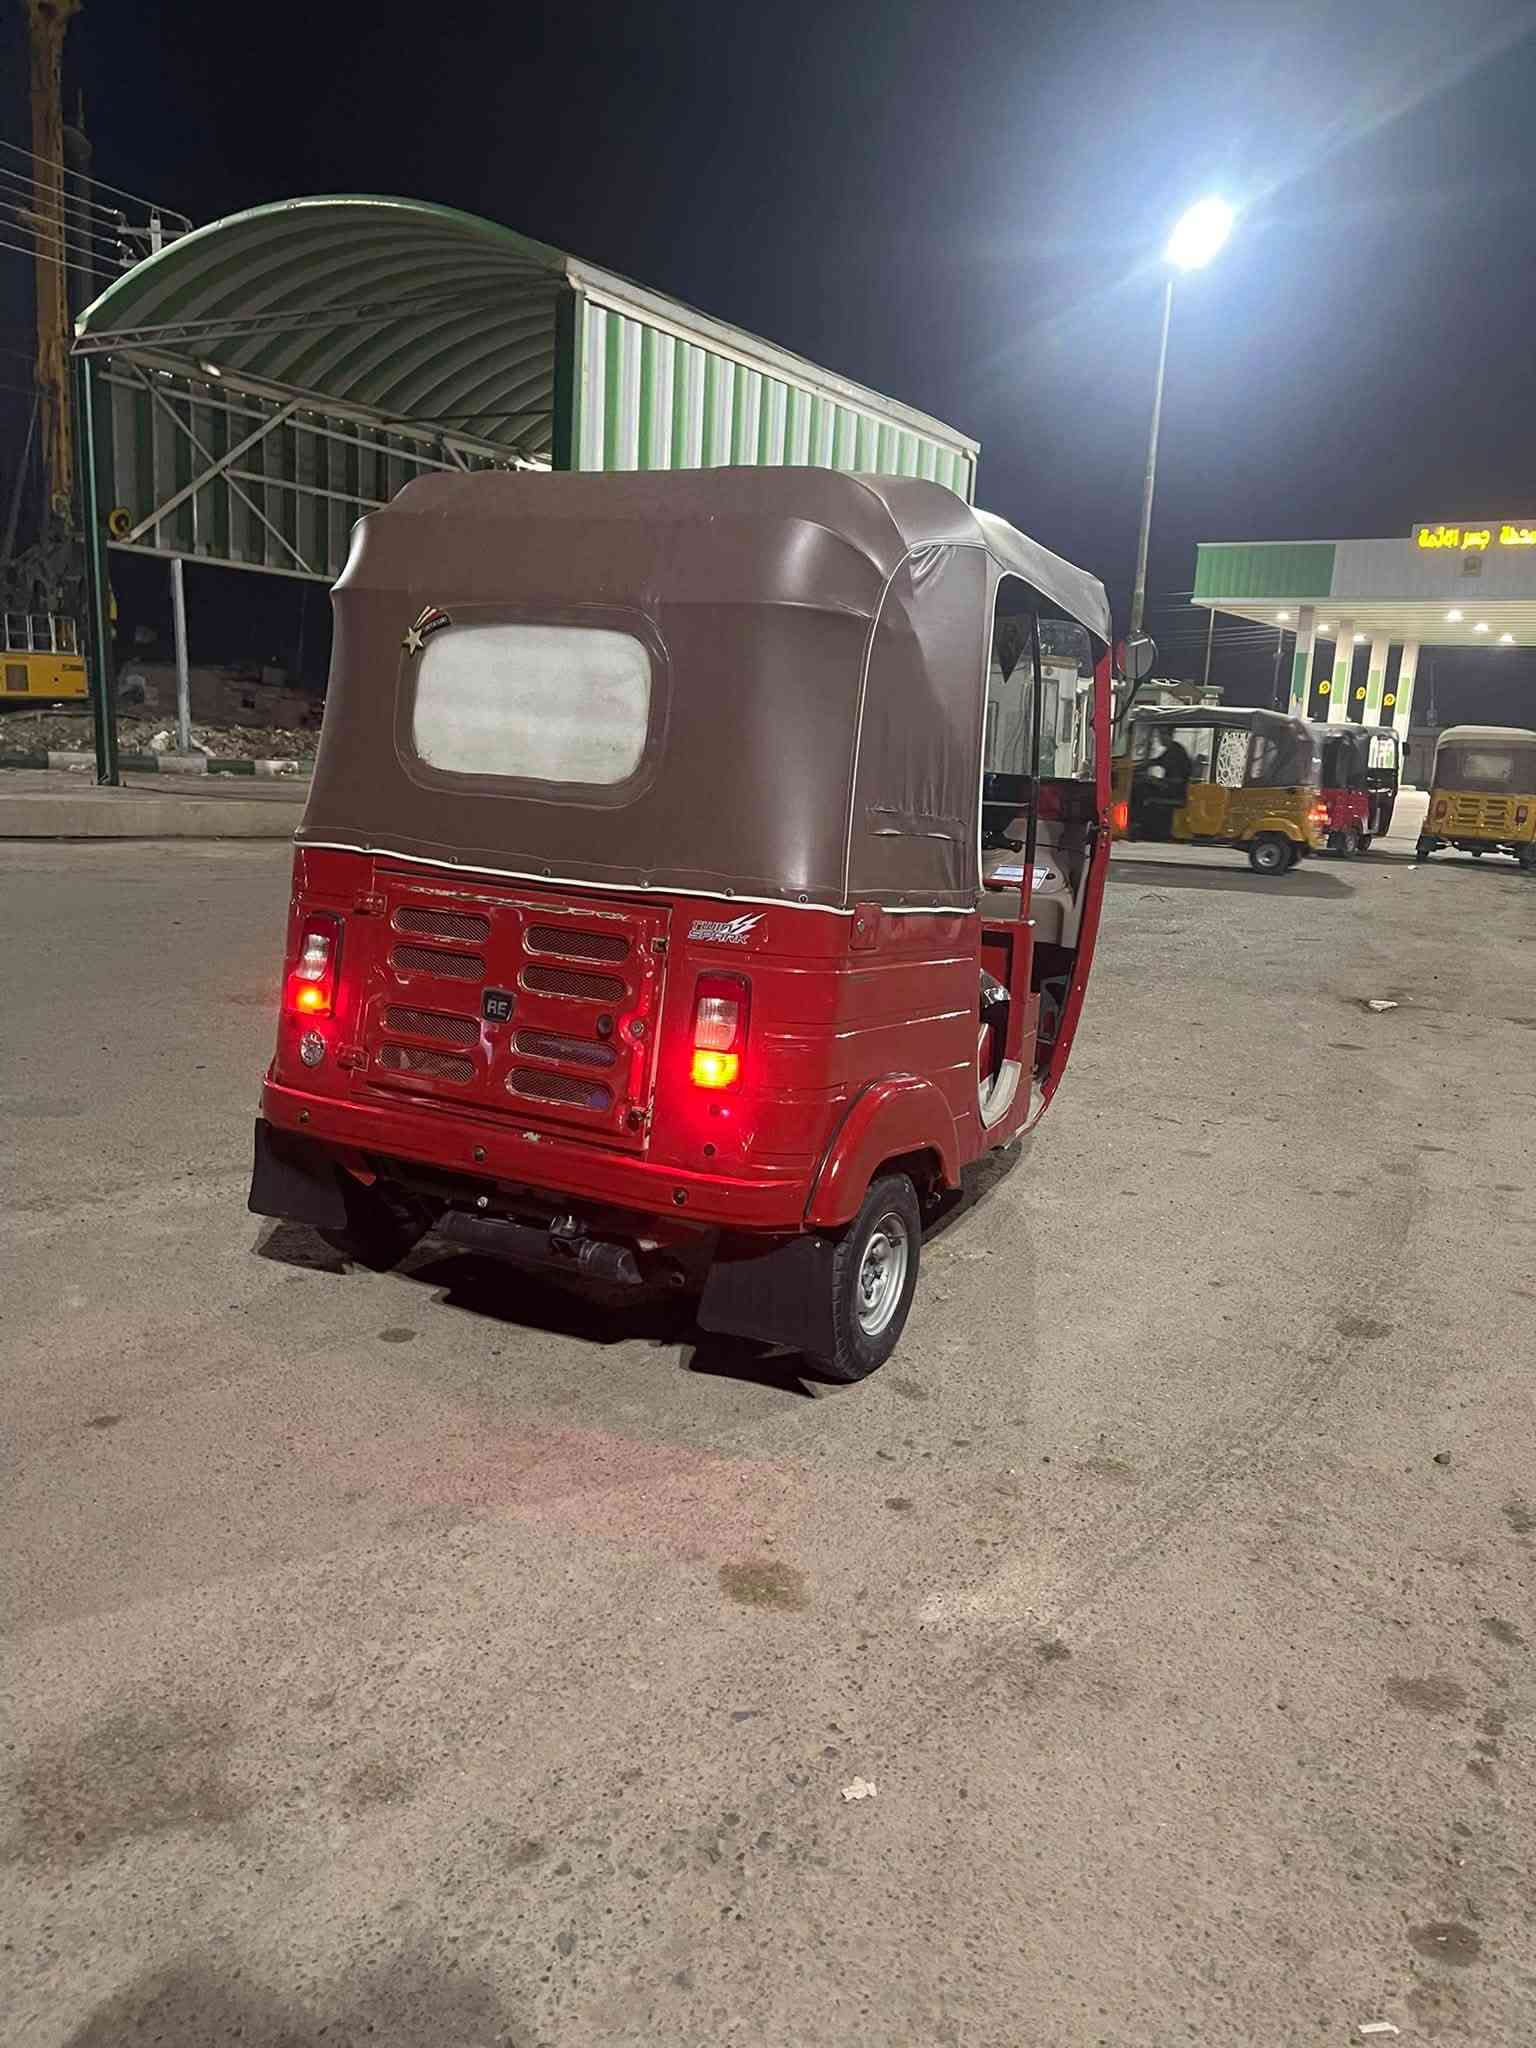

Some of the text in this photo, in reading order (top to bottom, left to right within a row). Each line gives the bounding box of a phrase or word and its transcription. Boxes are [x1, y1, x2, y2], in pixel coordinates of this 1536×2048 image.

[1460, 530, 1491, 551] جسر
[687, 929, 750, 944] SPARK
[487, 999, 508, 1017] RE
